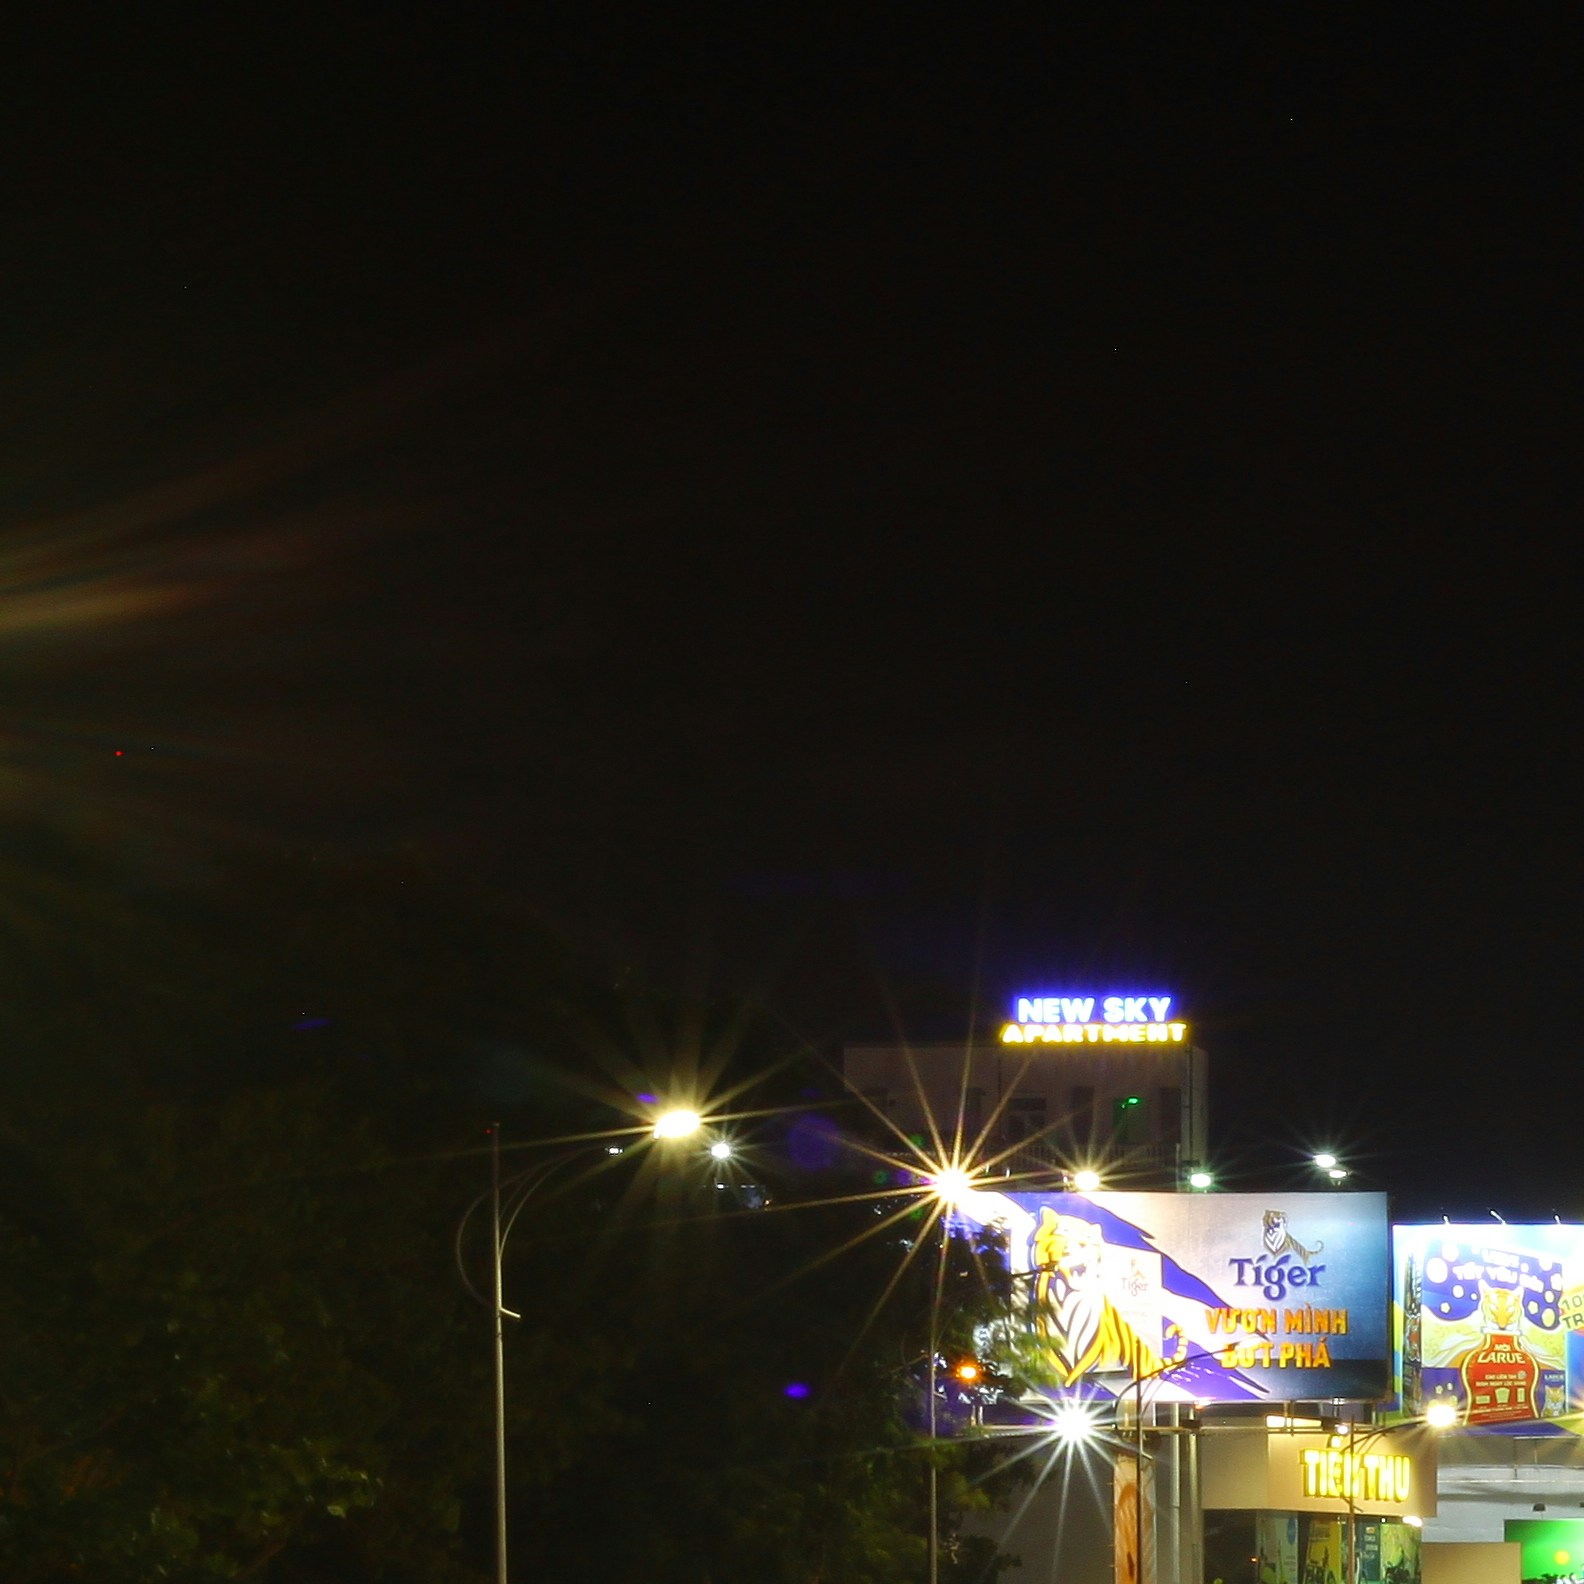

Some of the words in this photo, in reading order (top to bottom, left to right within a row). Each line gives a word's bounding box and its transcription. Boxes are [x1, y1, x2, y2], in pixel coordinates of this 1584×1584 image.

[1017, 997, 1095, 1023] NEW
[1103, 996, 1172, 1023] SKY
[1002, 1022, 1188, 1044] APARTMENT
[1229, 1253, 1327, 1300] Tiger
[1205, 1306, 1278, 1334] VƯƠN
[1284, 1302, 1348, 1335] MÌNH
[1278, 1336, 1332, 1369] PHÁ
[1477, 1351, 1526, 1364] LARUE
[1363, 1453, 1411, 1502] THU
